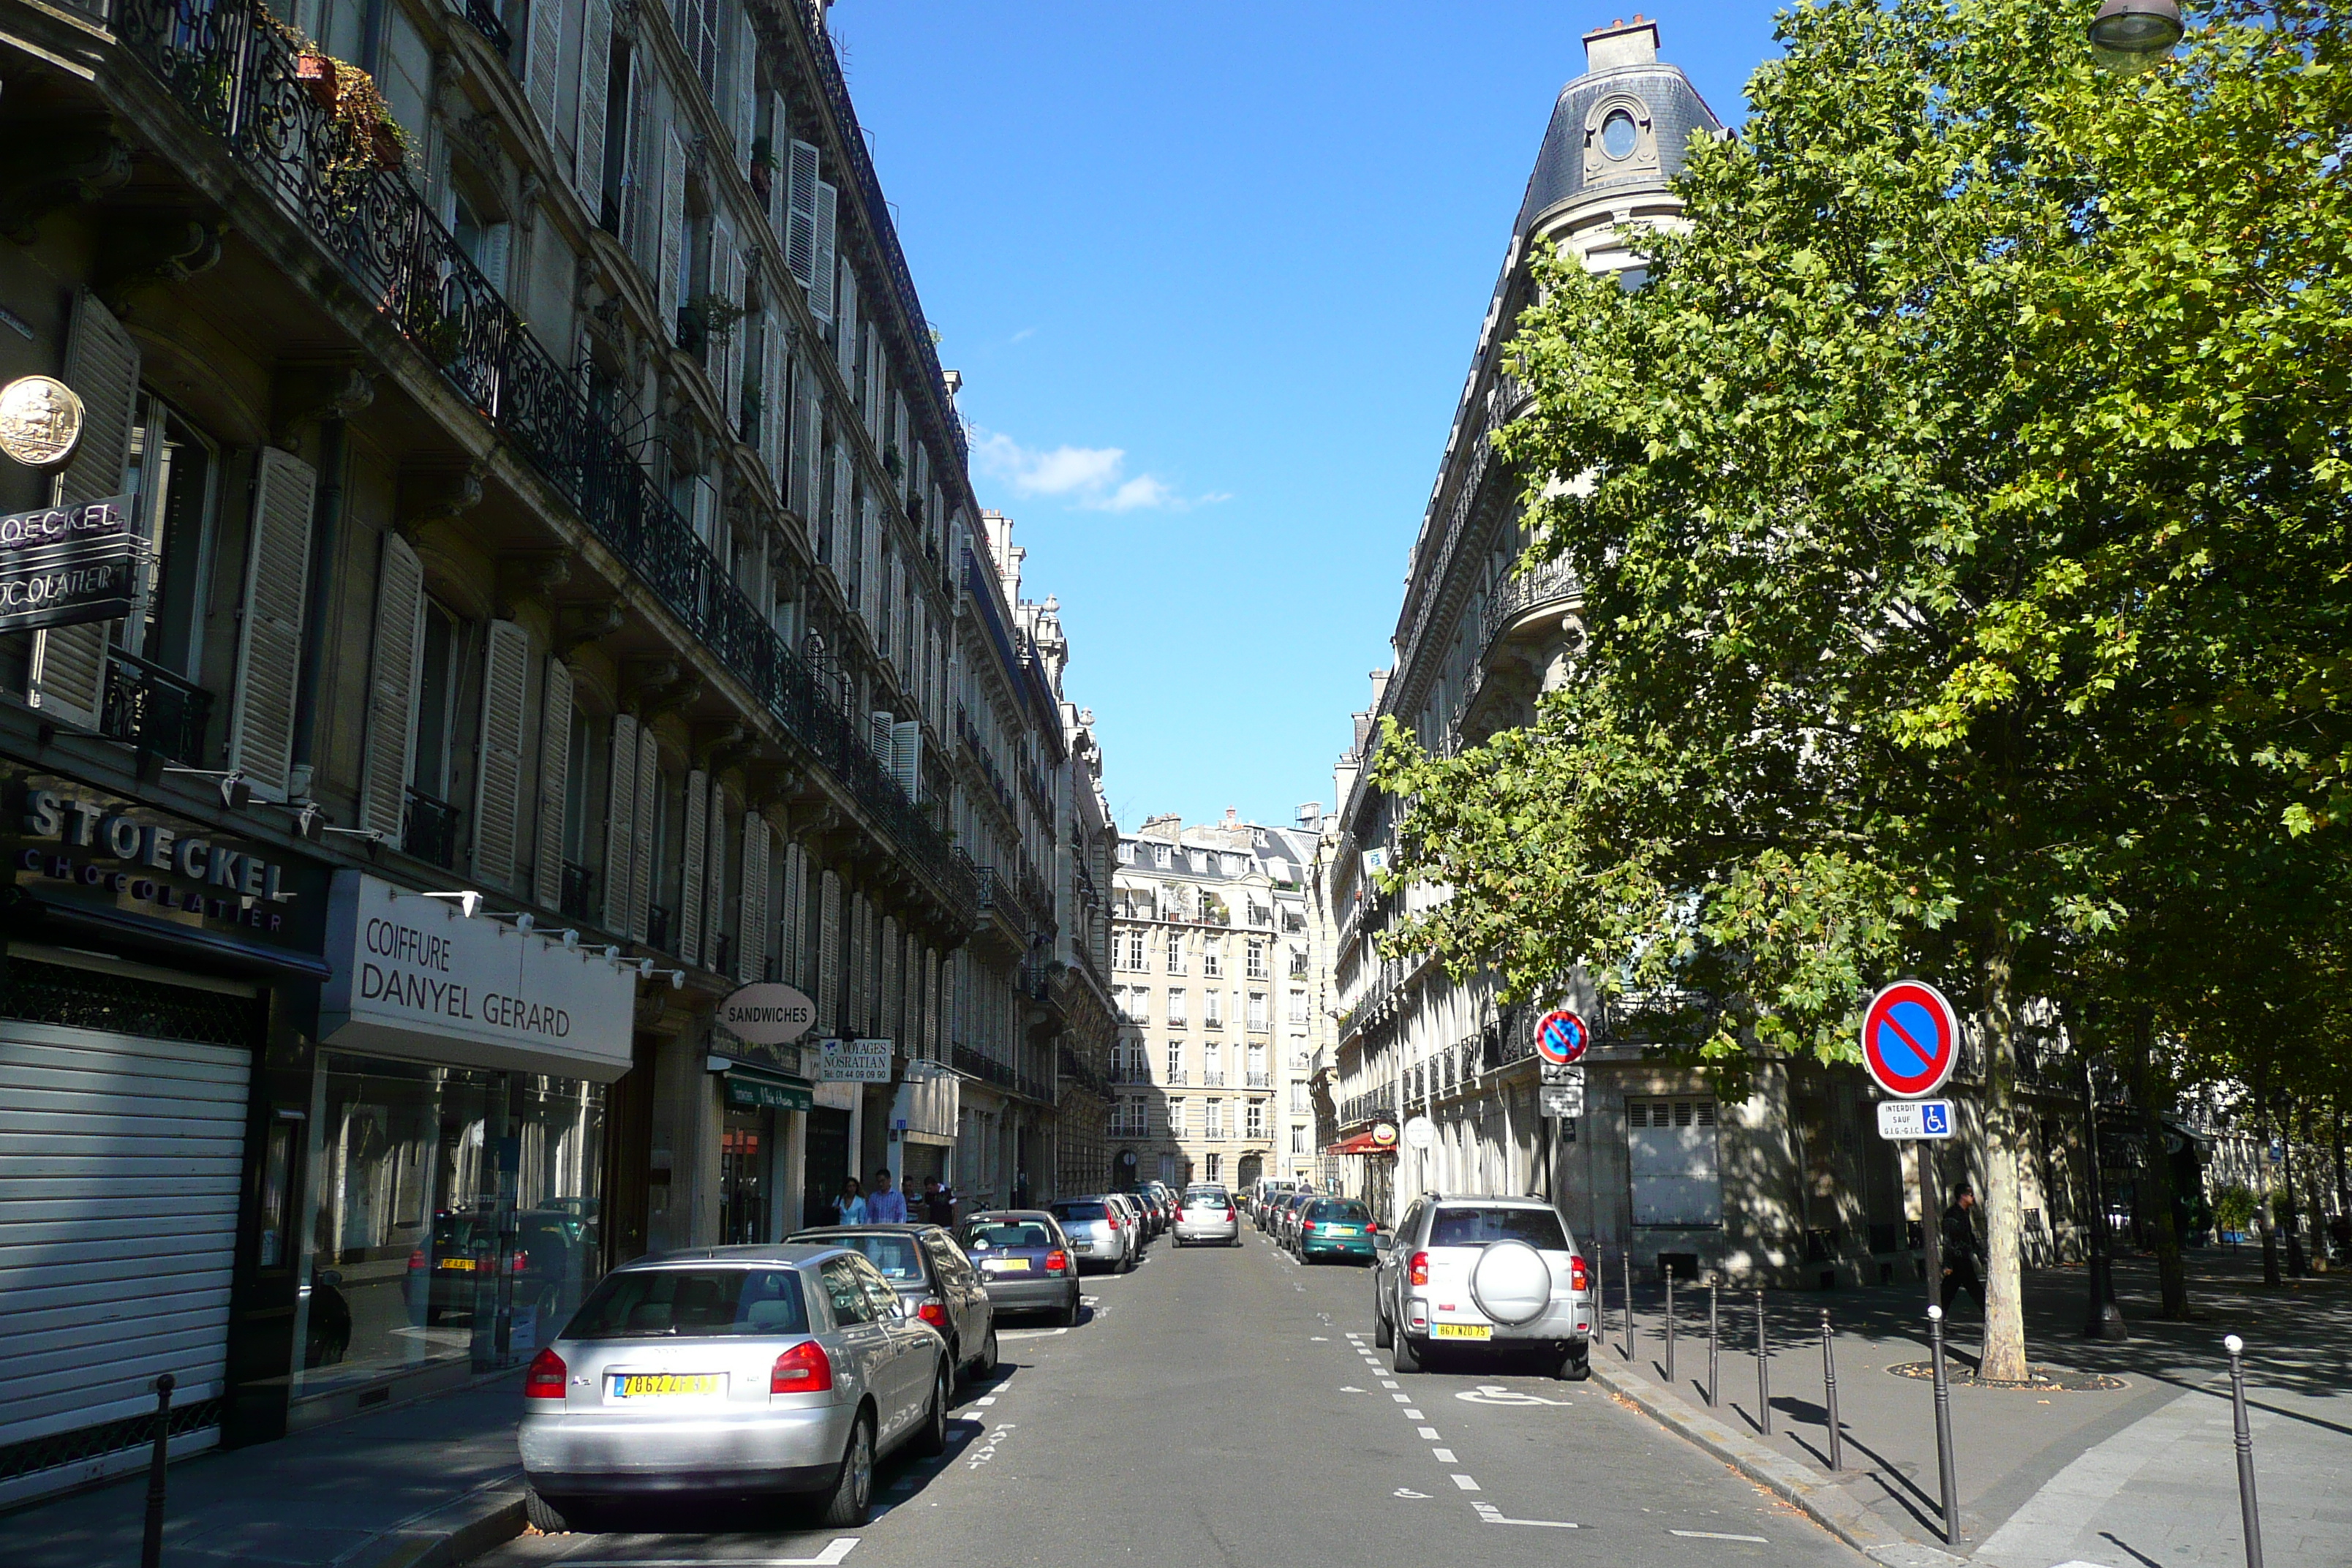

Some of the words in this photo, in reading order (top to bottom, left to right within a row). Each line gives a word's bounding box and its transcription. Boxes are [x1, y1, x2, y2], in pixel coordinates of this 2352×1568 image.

[24, 790, 287, 903] STOECKEL
[20, 848, 282, 932] CHOCOLATIER
[366, 917, 451, 973] COIFFURE
[361, 962, 473, 1020] DANYEL
[483, 992, 570, 1038] GERARD
[728, 1006, 808, 1023] SANDWICHES
[842, 1042, 886, 1055] VOYAGES
[824, 1056, 886, 1068] NOSRATIAN
[836, 1070, 843, 1078] 01
[845, 1070, 853, 1078] 44
[856, 1070, 864, 1078] 09
[866, 1070, 875, 1079] 09
[877, 1071, 886, 1079] 90
[1885, 1104, 1916, 1112] INTERDIT
[1893, 1115, 1911, 1123] SAUF
[1440, 1326, 1455, 1335] 867
[1476, 1327, 1485, 1336] 75
[625, 1376, 664, 1392] 7862
